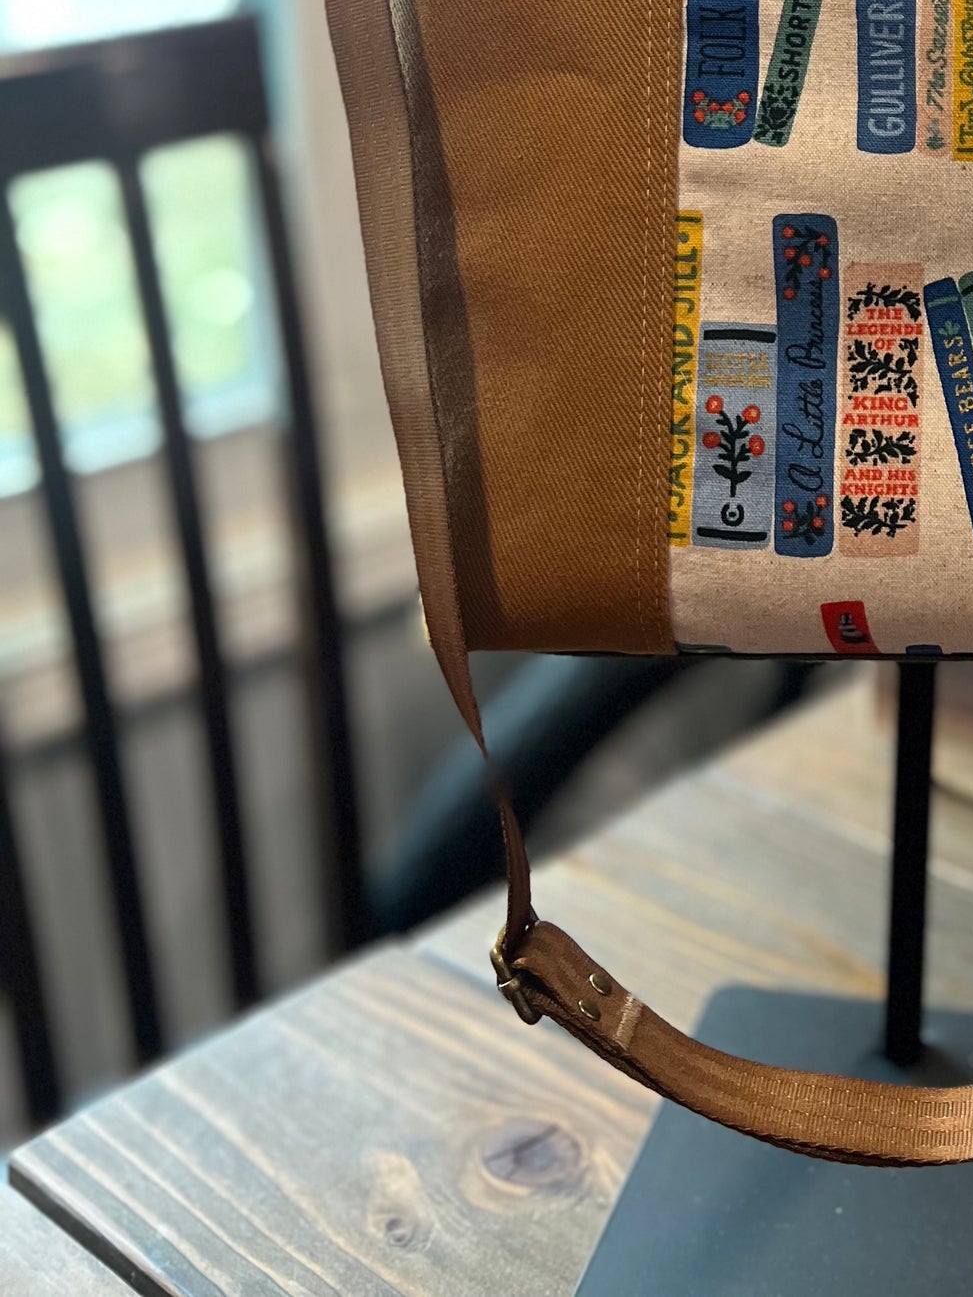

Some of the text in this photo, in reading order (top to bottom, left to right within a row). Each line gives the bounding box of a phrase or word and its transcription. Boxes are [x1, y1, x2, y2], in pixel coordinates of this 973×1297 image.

[699, 6, 747, 78] FOLK
[865, 308, 905, 321] THE
[786, 279, 826, 371] Princess
[846, 323, 923, 336] LEGENDS
[874, 338, 896, 351] OF
[667, 247, 698, 508] JACK AND JILL
[852, 396, 908, 412] KING
[782, 376, 824, 458] Little
[842, 413, 920, 428] ARTHUR
[844, 469, 917, 482] AND HIS
[840, 483, 919, 497] KNIGHTS
